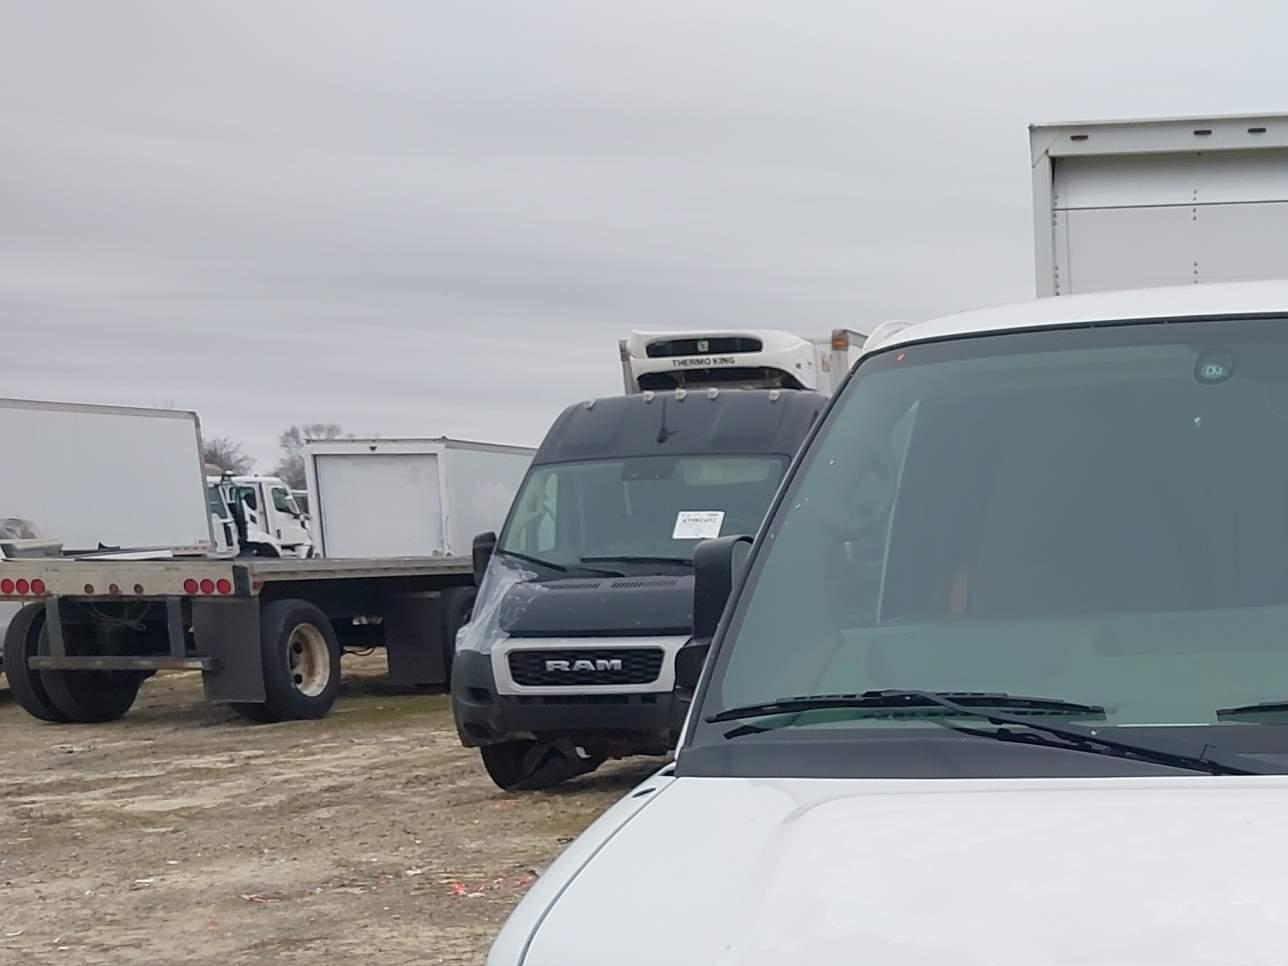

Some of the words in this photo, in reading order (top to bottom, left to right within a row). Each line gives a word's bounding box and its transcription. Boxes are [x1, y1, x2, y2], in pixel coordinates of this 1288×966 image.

[672, 357, 712, 367] THERMO
[713, 356, 736, 366] KING
[545, 659, 622, 672] RAM
